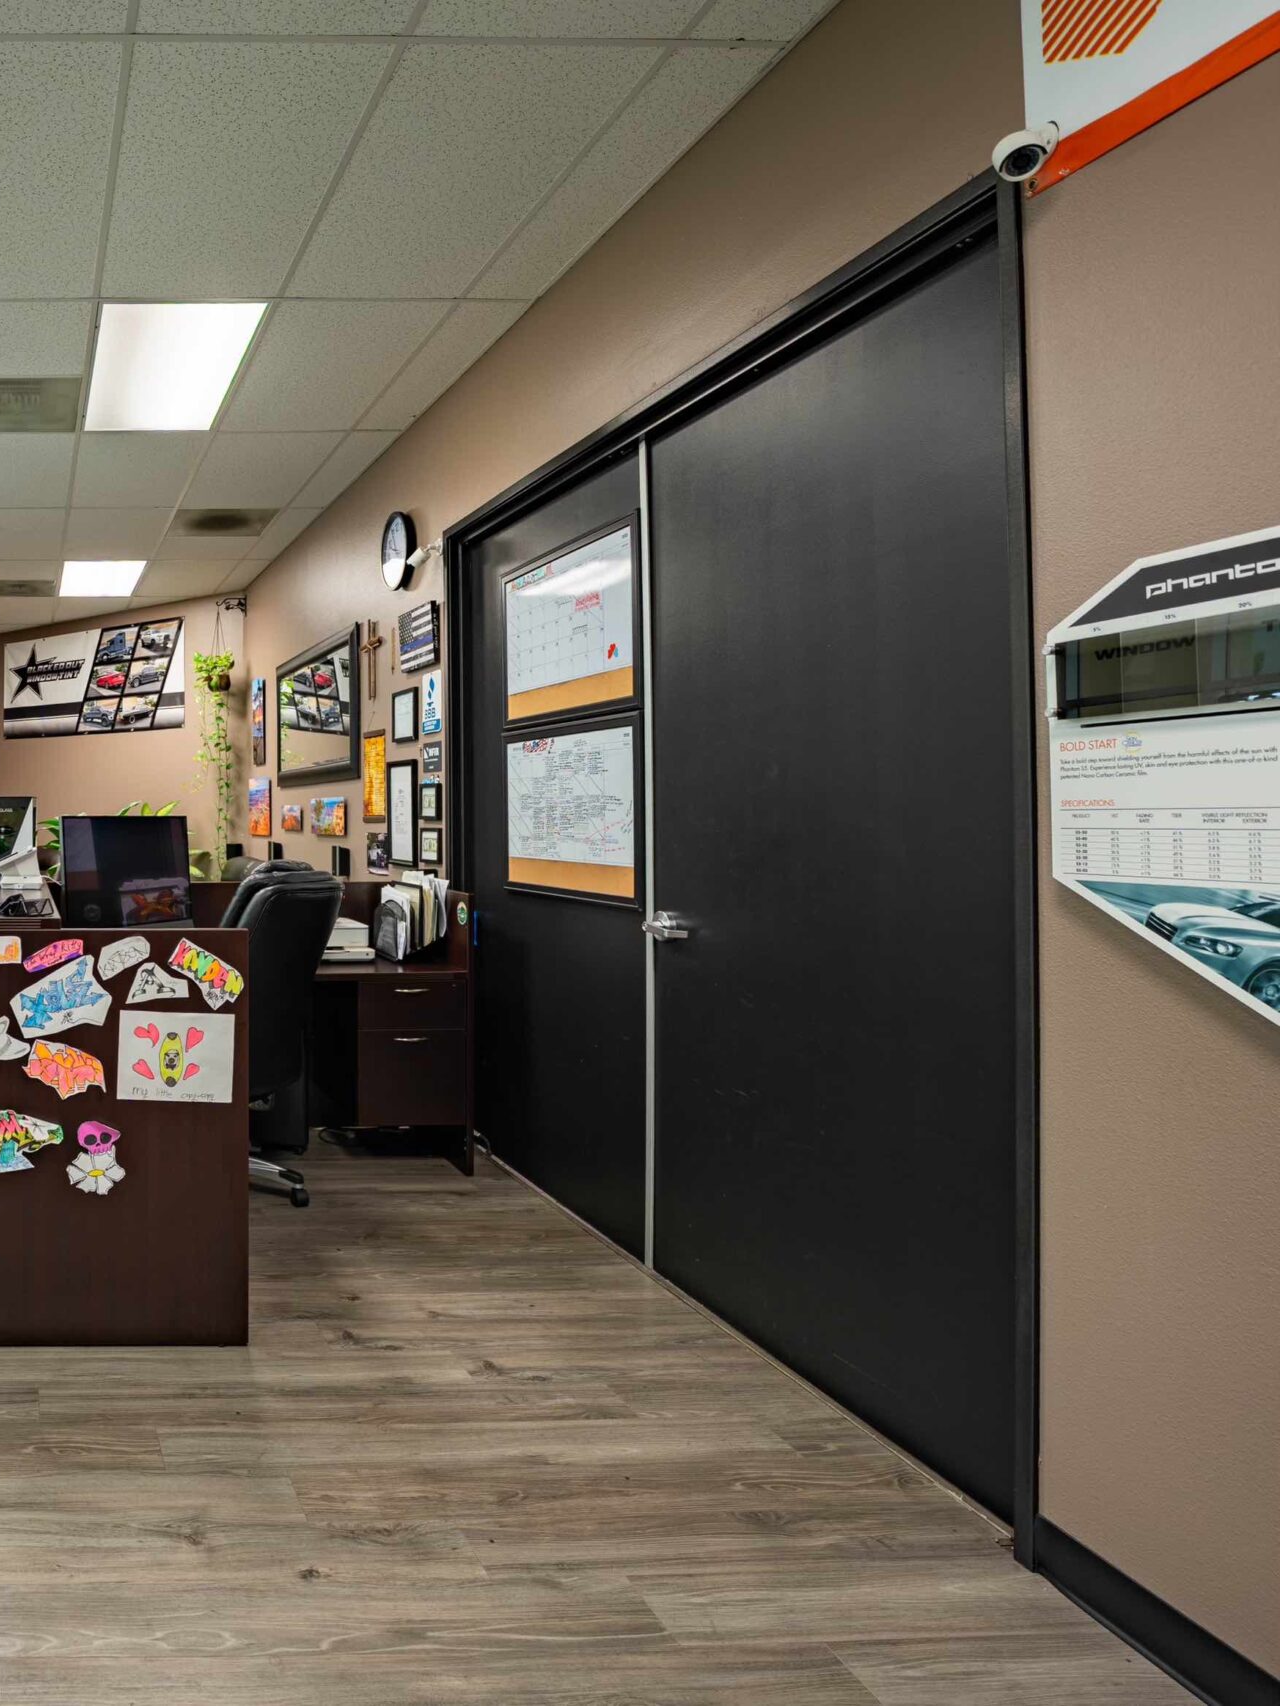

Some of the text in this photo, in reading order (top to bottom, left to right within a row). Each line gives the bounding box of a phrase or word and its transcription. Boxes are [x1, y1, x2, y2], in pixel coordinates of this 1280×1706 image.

[1094, 634, 1196, 661] WINDOW
[1059, 741, 1086, 752] BOLD
[1088, 738, 1117, 750] START
[1060, 799, 1115, 808] SPECIFICATIONS
